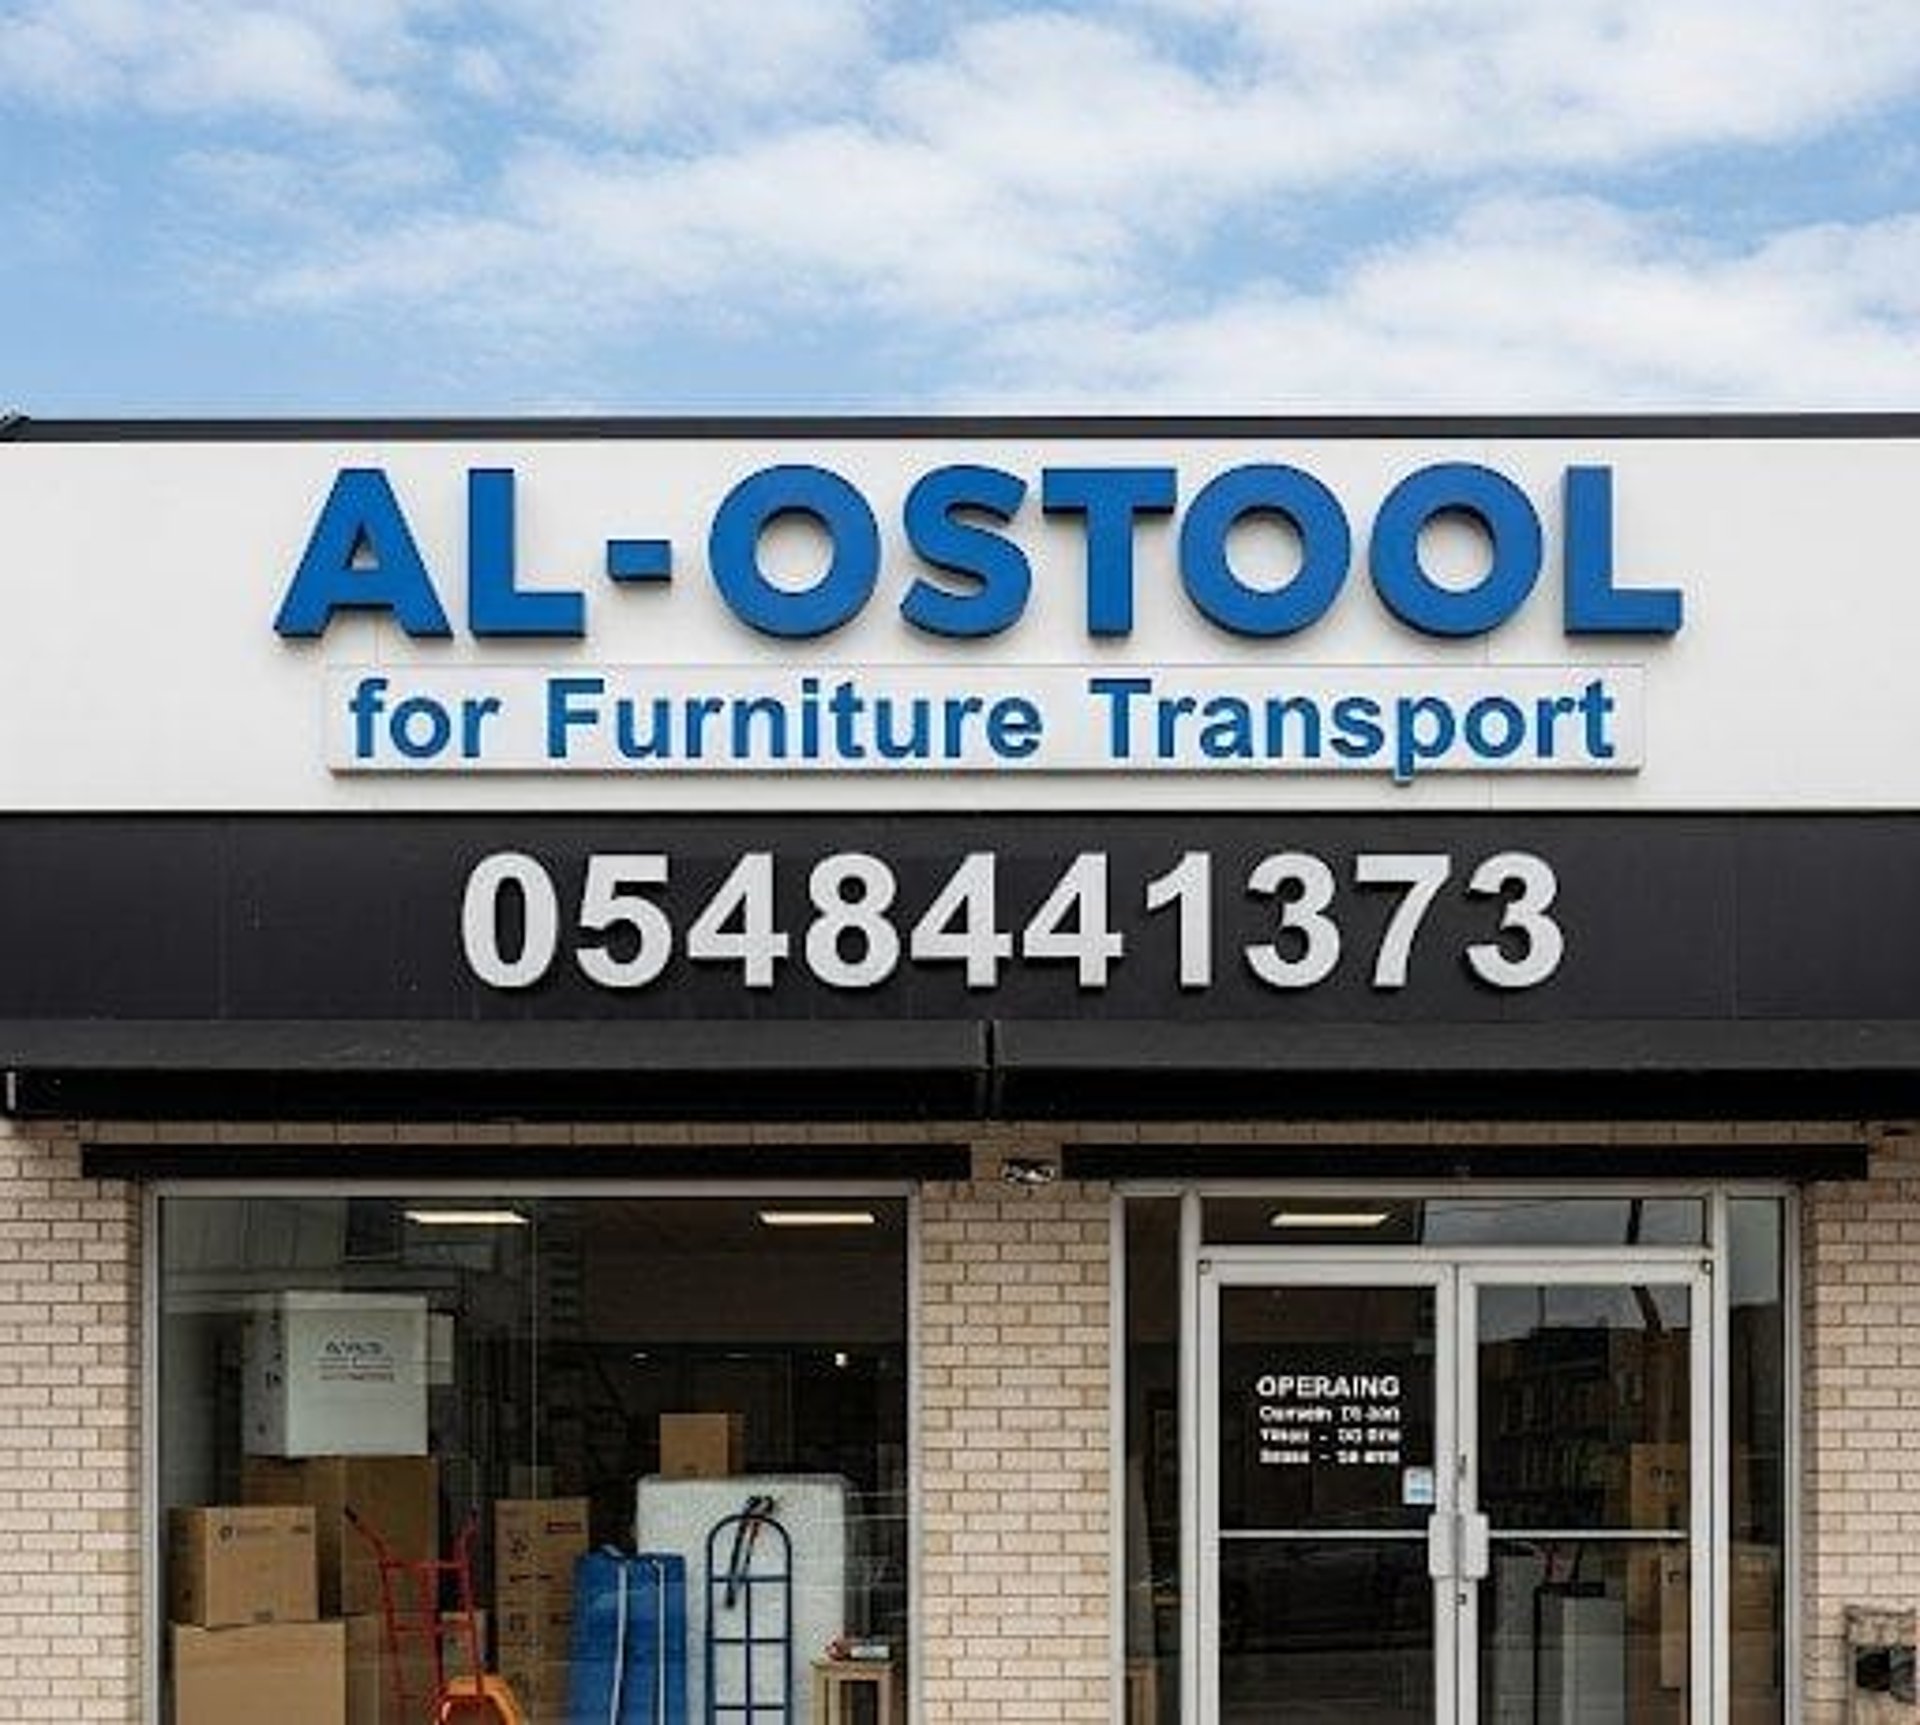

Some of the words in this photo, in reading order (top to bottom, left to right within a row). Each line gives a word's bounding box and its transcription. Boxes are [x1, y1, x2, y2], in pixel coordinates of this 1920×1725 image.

[273, 463, 1684, 638] AL-OSTOOL
[350, 676, 500, 762] for
[545, 677, 1044, 762] Furniture
[1090, 677, 1615, 778] Transport
[462, 851, 1565, 988] 0548441373
[1256, 1375, 1400, 1398] OPERAING
